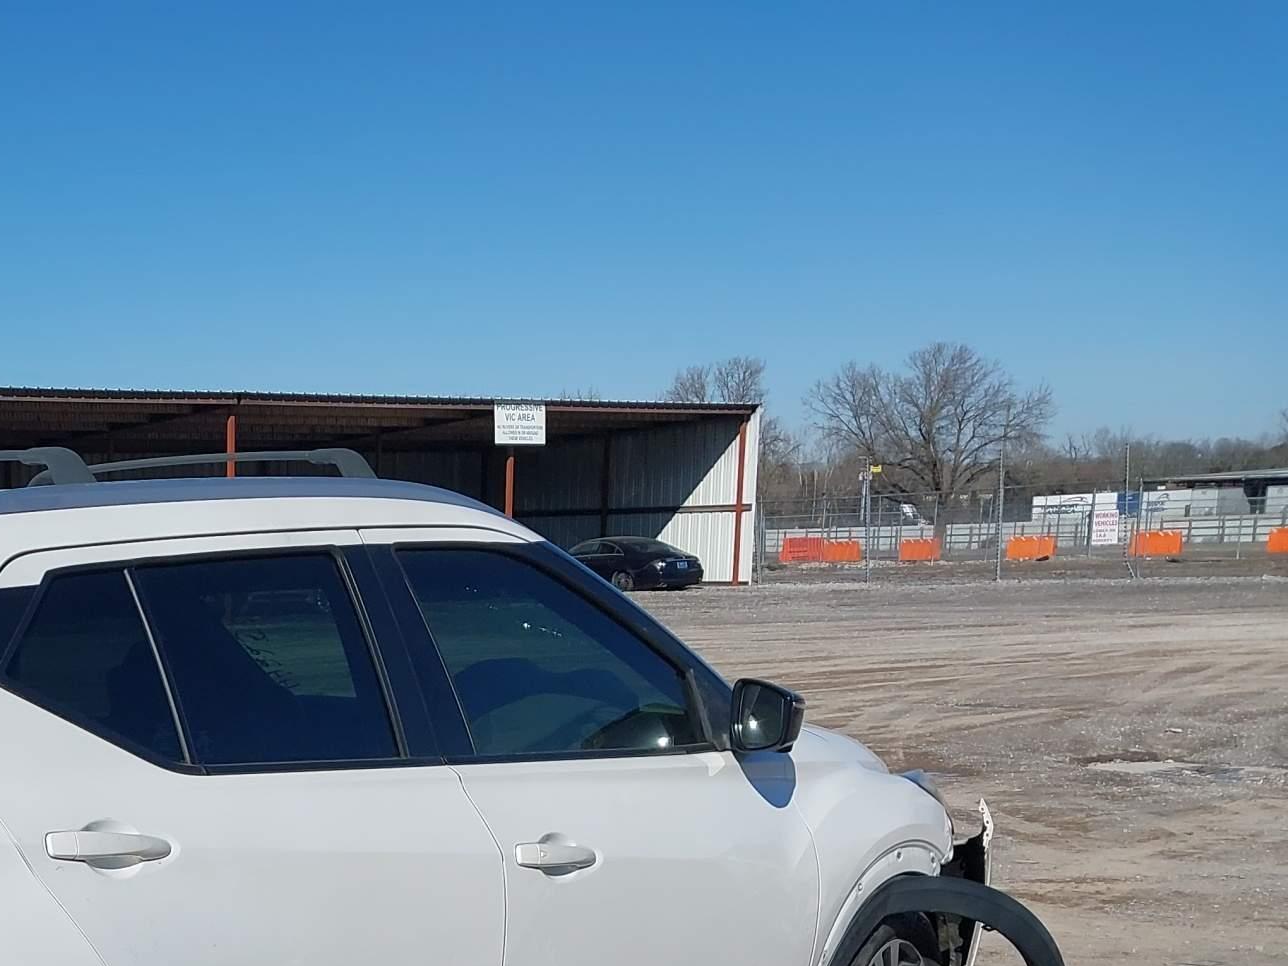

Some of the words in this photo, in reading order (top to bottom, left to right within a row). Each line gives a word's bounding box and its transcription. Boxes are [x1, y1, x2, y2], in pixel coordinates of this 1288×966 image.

[496, 403, 544, 412] PROGRESSIVE
[504, 412, 516, 422] VIC
[517, 412, 536, 422] AREA
